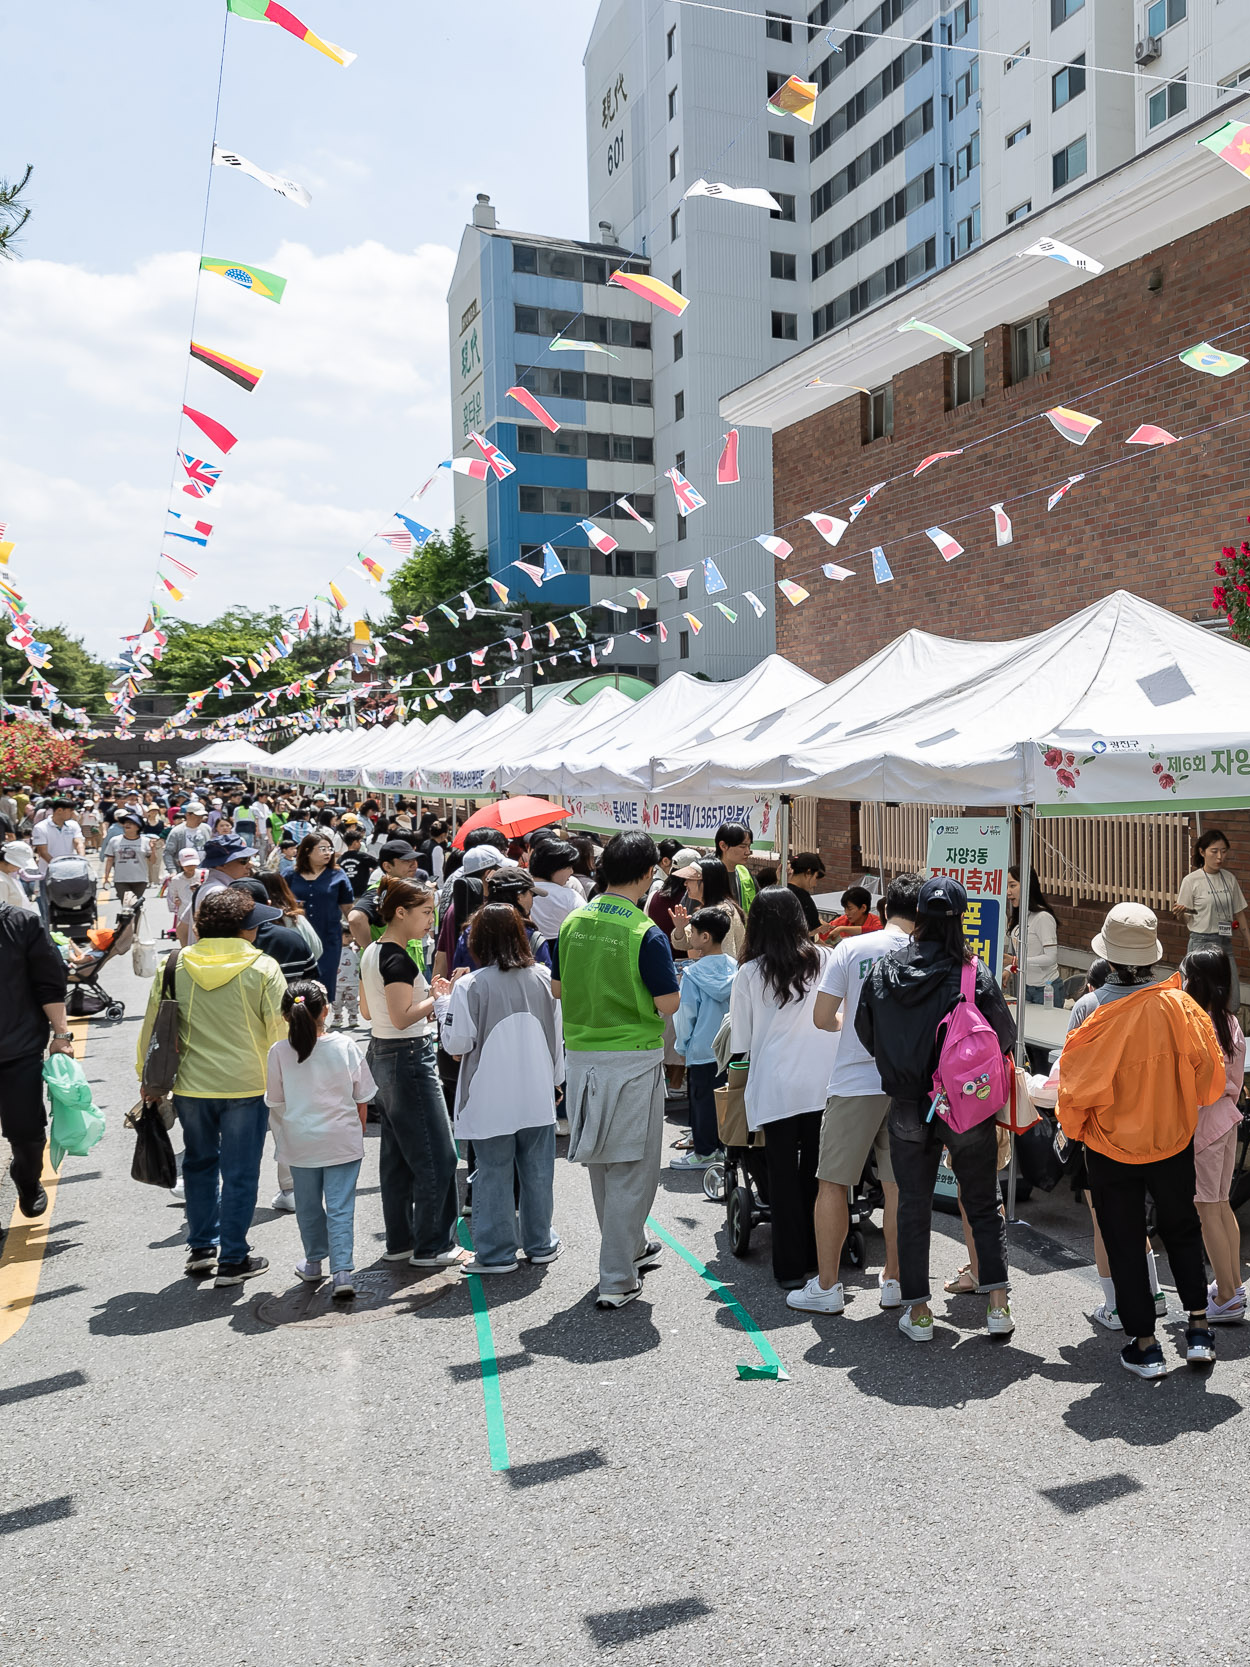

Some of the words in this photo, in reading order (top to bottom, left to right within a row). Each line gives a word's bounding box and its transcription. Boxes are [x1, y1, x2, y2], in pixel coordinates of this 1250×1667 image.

[608, 129, 624, 176] 601
[1167, 756, 1206, 773] 제6회
[946, 848, 988, 864] 자양3동
